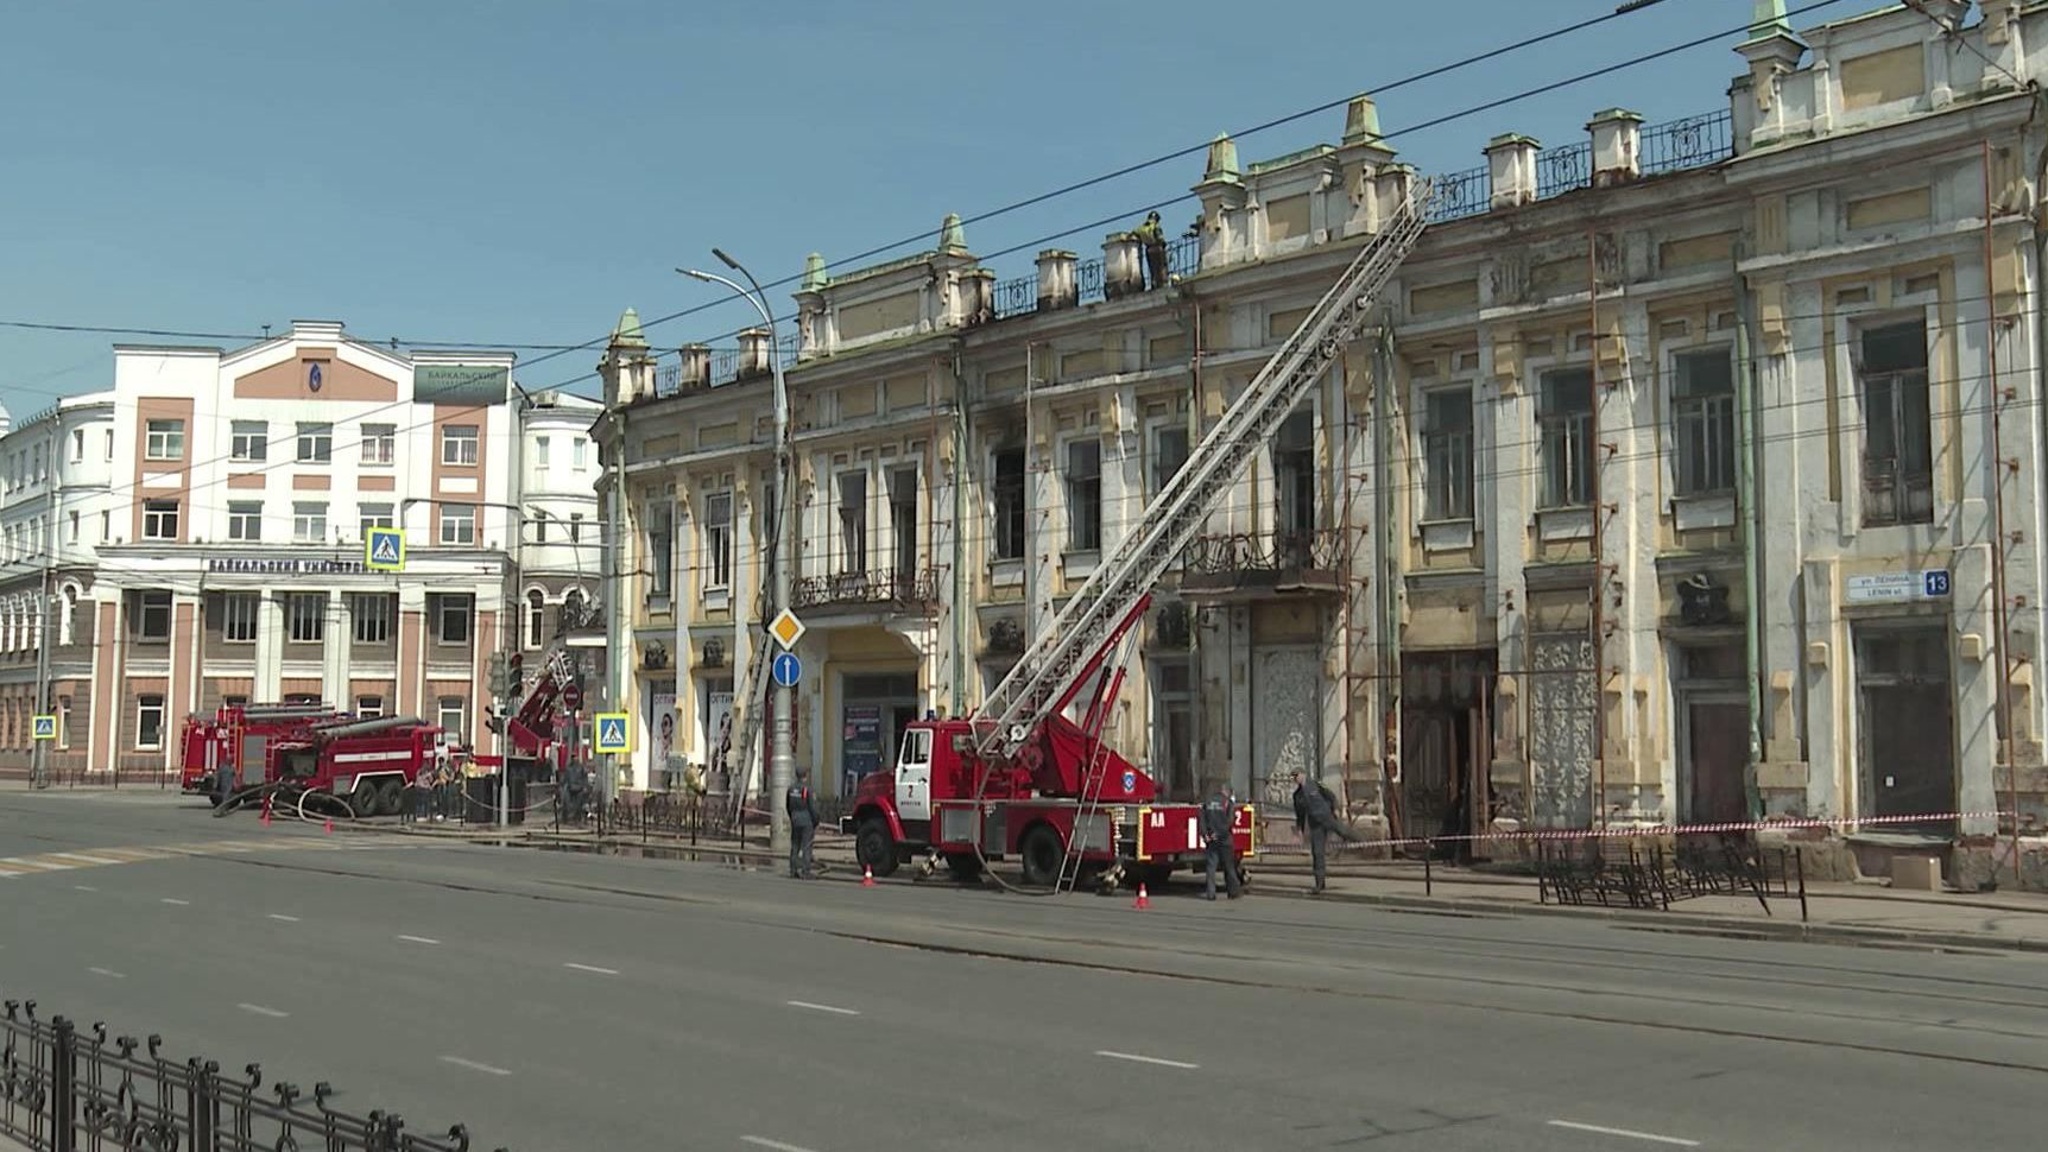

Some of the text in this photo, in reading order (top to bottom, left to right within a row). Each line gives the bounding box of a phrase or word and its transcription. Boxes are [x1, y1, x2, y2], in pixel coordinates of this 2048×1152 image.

[209, 559, 299, 573] БАЙКАЛЬСКИЙ
[1928, 576, 1947, 591] 13
[1867, 588, 1892, 596] LENIN
[1234, 810, 1242, 825] 2
